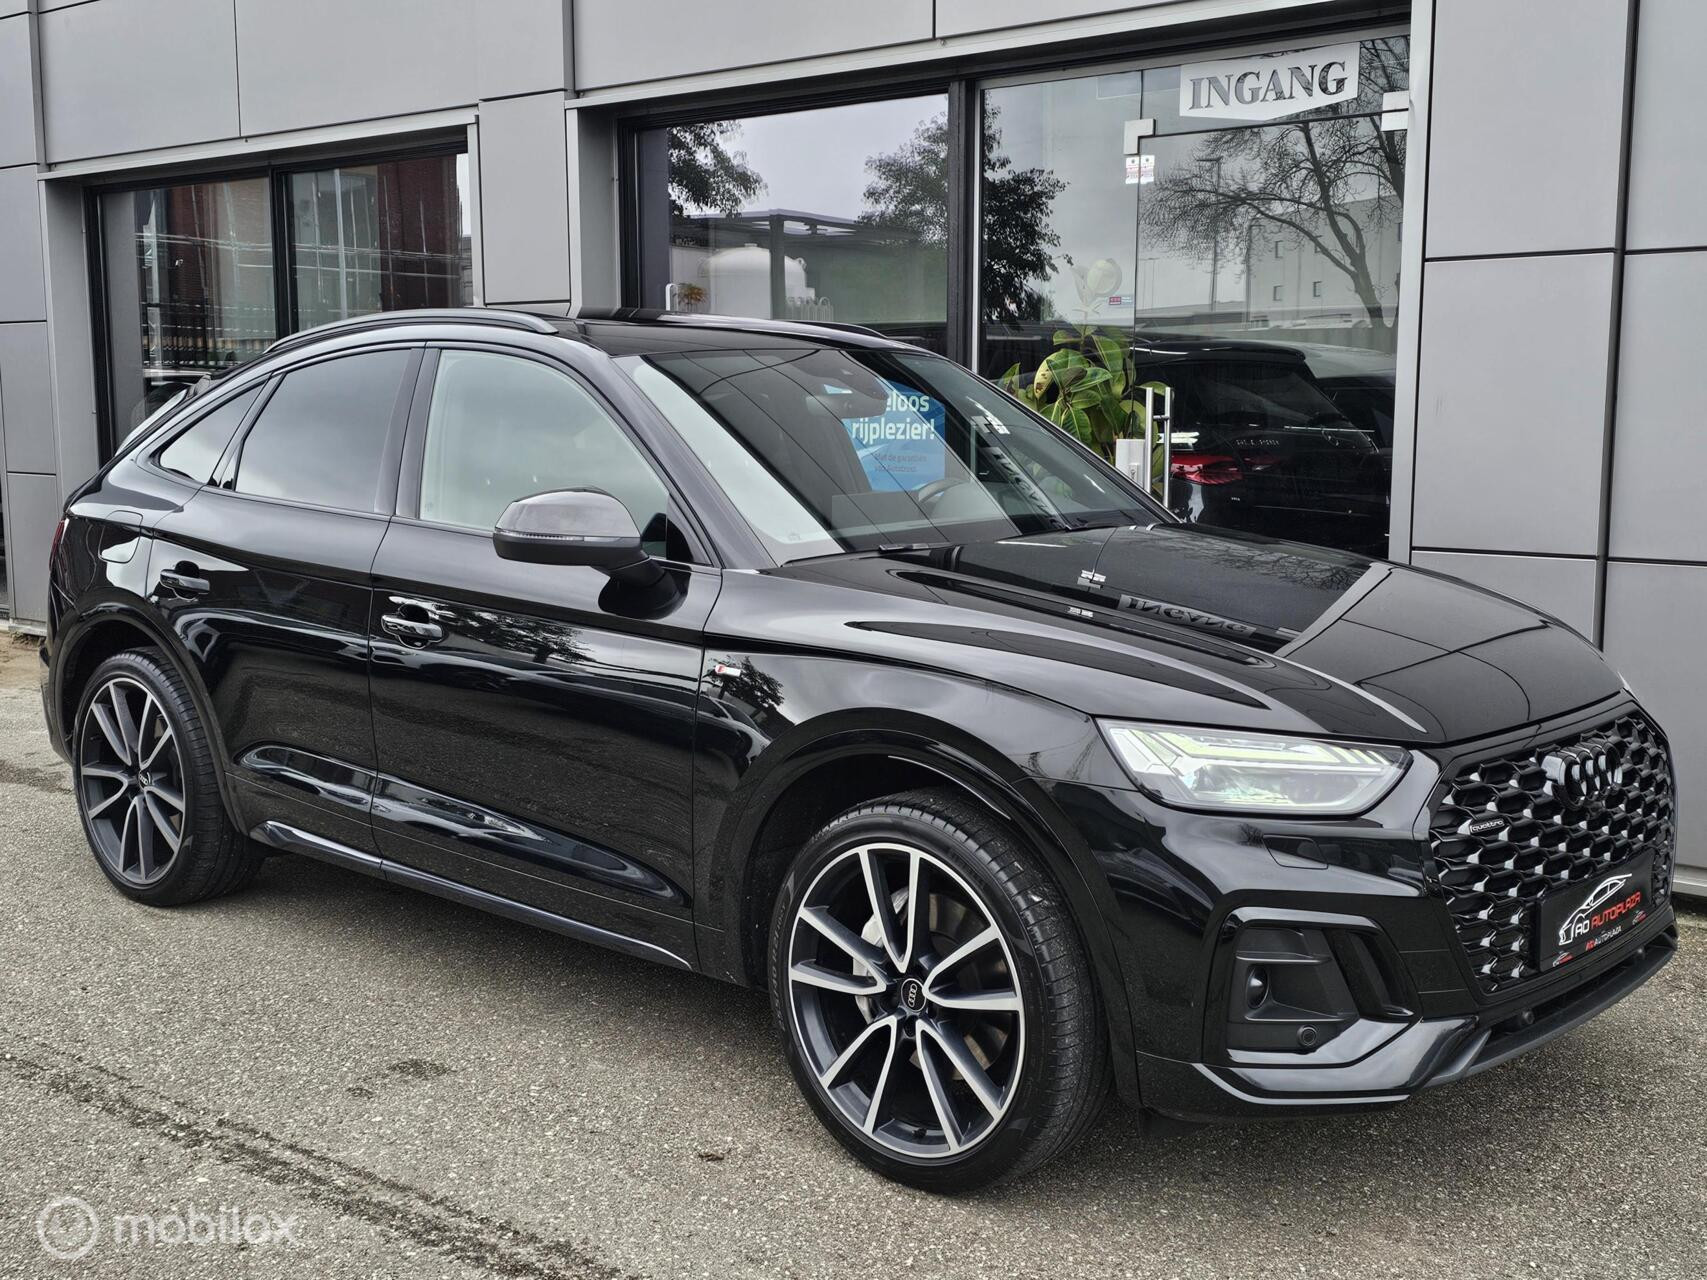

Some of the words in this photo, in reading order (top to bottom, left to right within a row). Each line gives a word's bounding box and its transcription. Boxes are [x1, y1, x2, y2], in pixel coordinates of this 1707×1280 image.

[1188, 60, 1348, 111] INGANG
[851, 417, 935, 445] rijplezier!
[1472, 819, 1503, 833] quattro
[1574, 919, 1590, 938] AD
[1591, 891, 1641, 929] AUTOPLAZA
